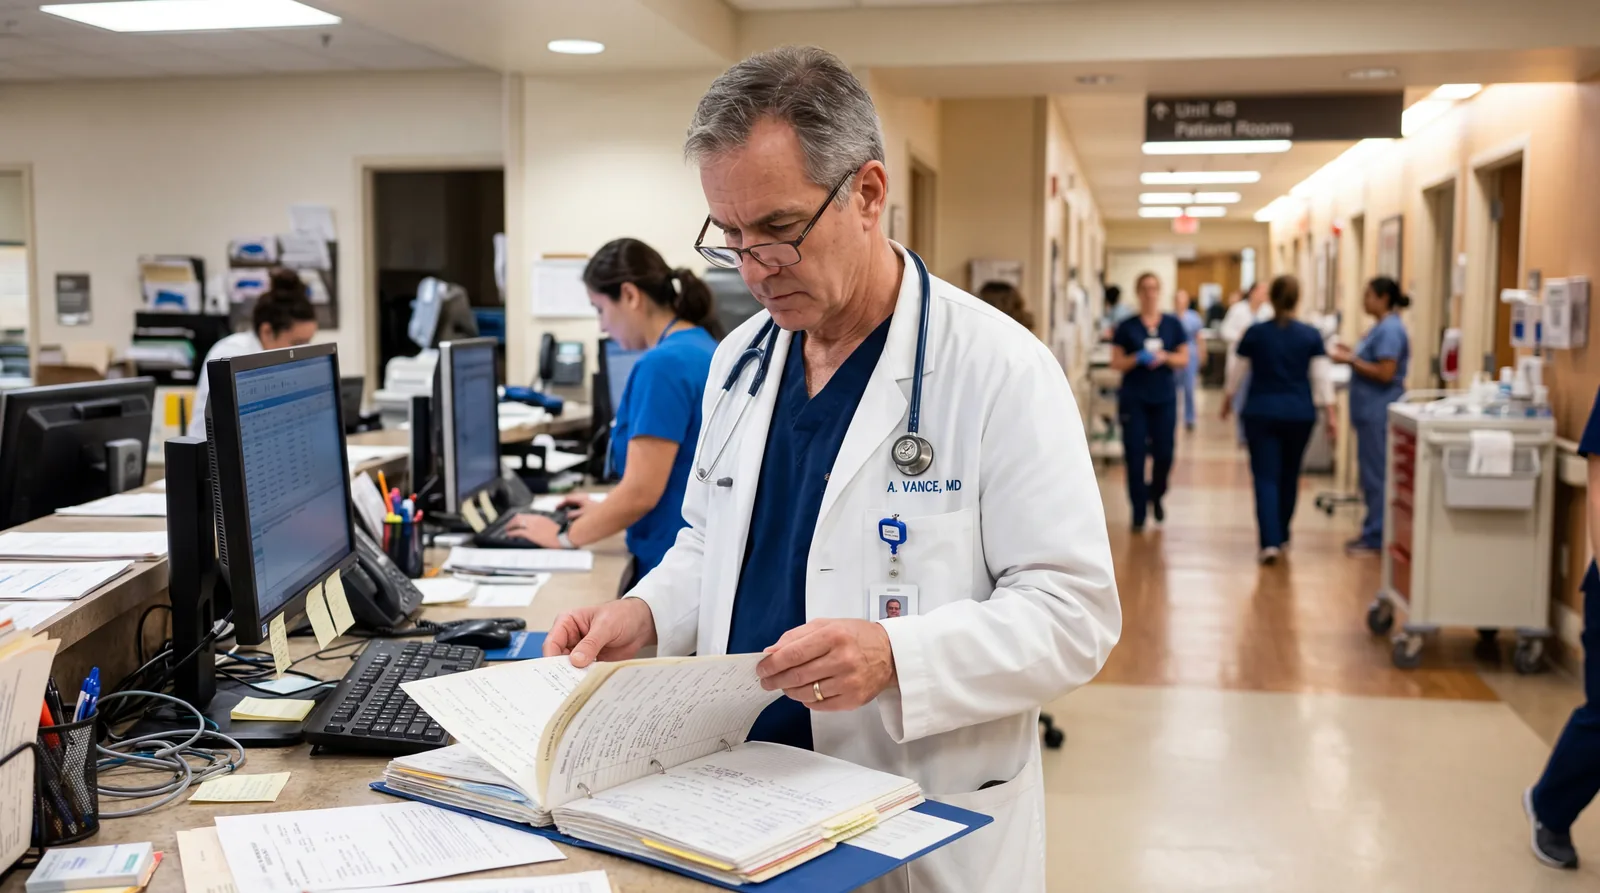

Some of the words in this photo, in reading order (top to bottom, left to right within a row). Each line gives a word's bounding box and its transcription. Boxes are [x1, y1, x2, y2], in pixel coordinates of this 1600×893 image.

[1175, 102, 1210, 118] Unit
[1175, 121, 1232, 138] Patient
[1235, 121, 1294, 138] Rooms
[887, 481, 898, 492] A.
[902, 480, 942, 493] VANCE,
[945, 479, 962, 491] MD
